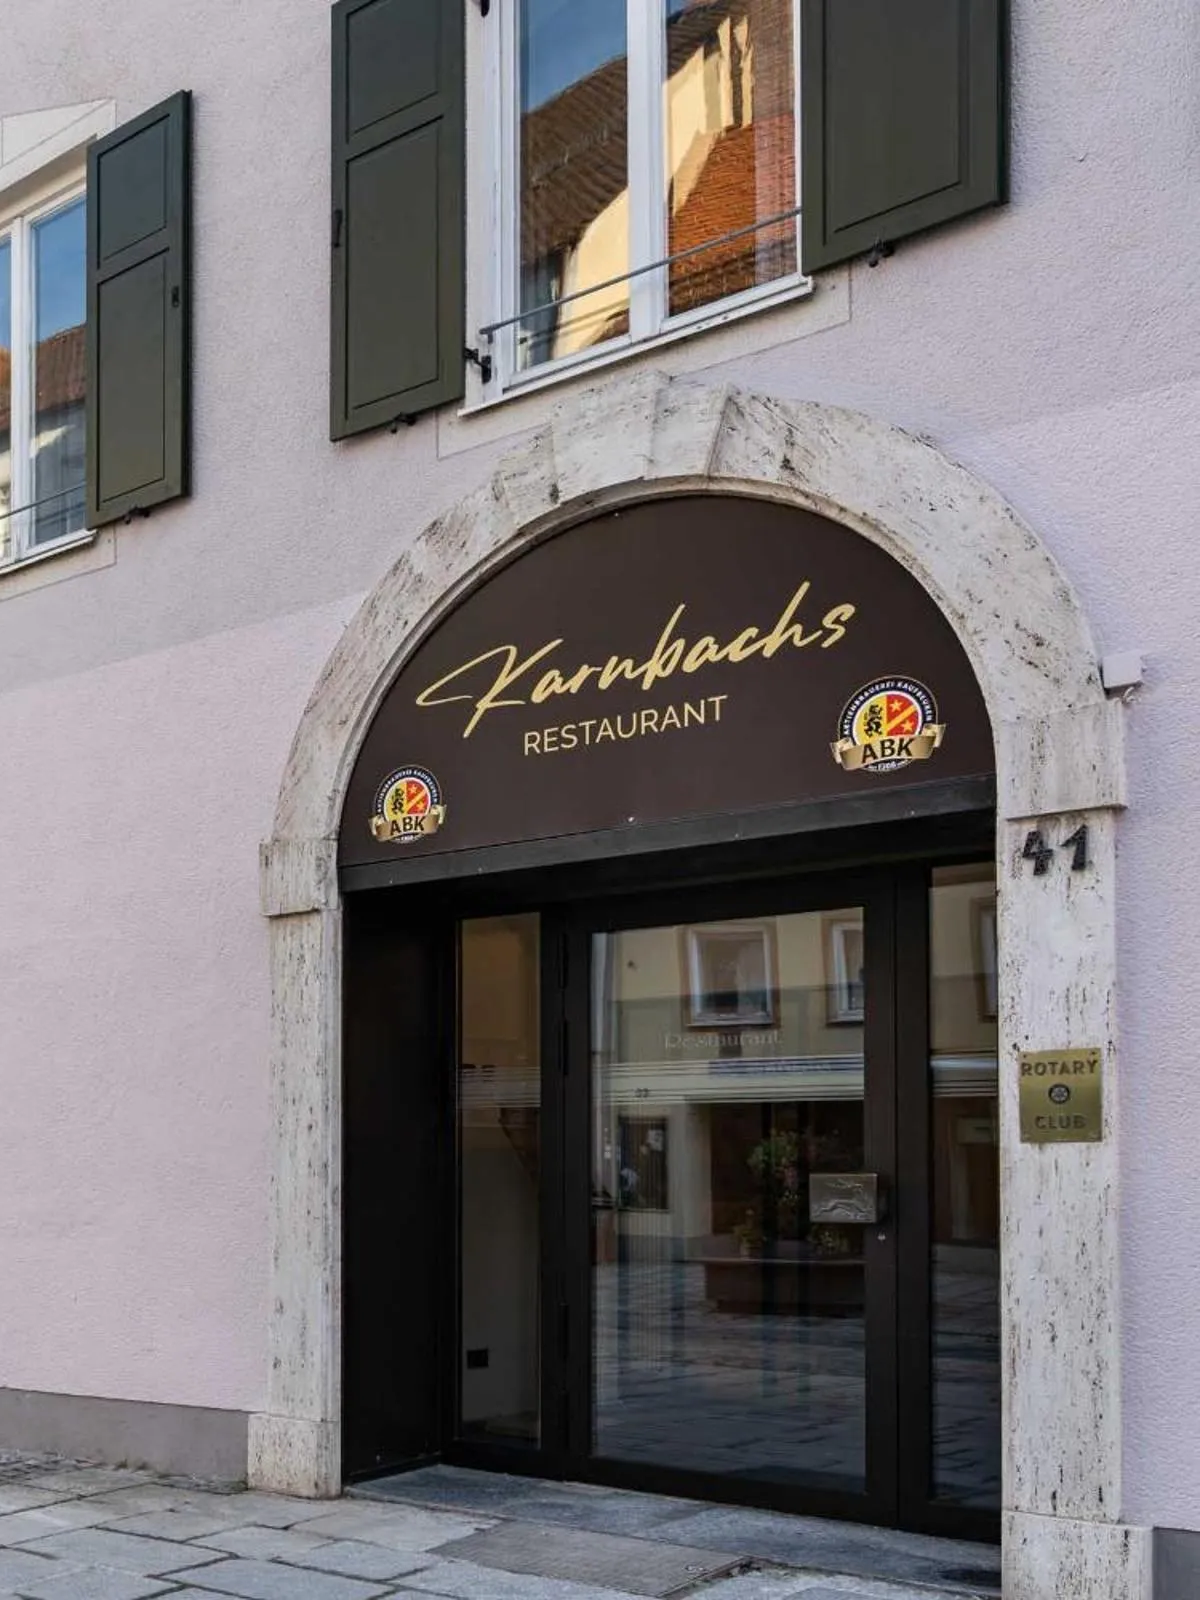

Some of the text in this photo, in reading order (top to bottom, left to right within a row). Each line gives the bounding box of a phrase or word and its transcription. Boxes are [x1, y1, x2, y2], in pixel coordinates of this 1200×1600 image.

[415, 579, 856, 739] Karnbachs
[522, 694, 728, 756] RESTAURANT
[861, 737, 915, 764] ABK
[389, 815, 425, 836] ABK
[1021, 823, 1089, 877] 41
[1020, 1059, 1098, 1078] ROTARY
[1034, 1114, 1087, 1131] CLUB
